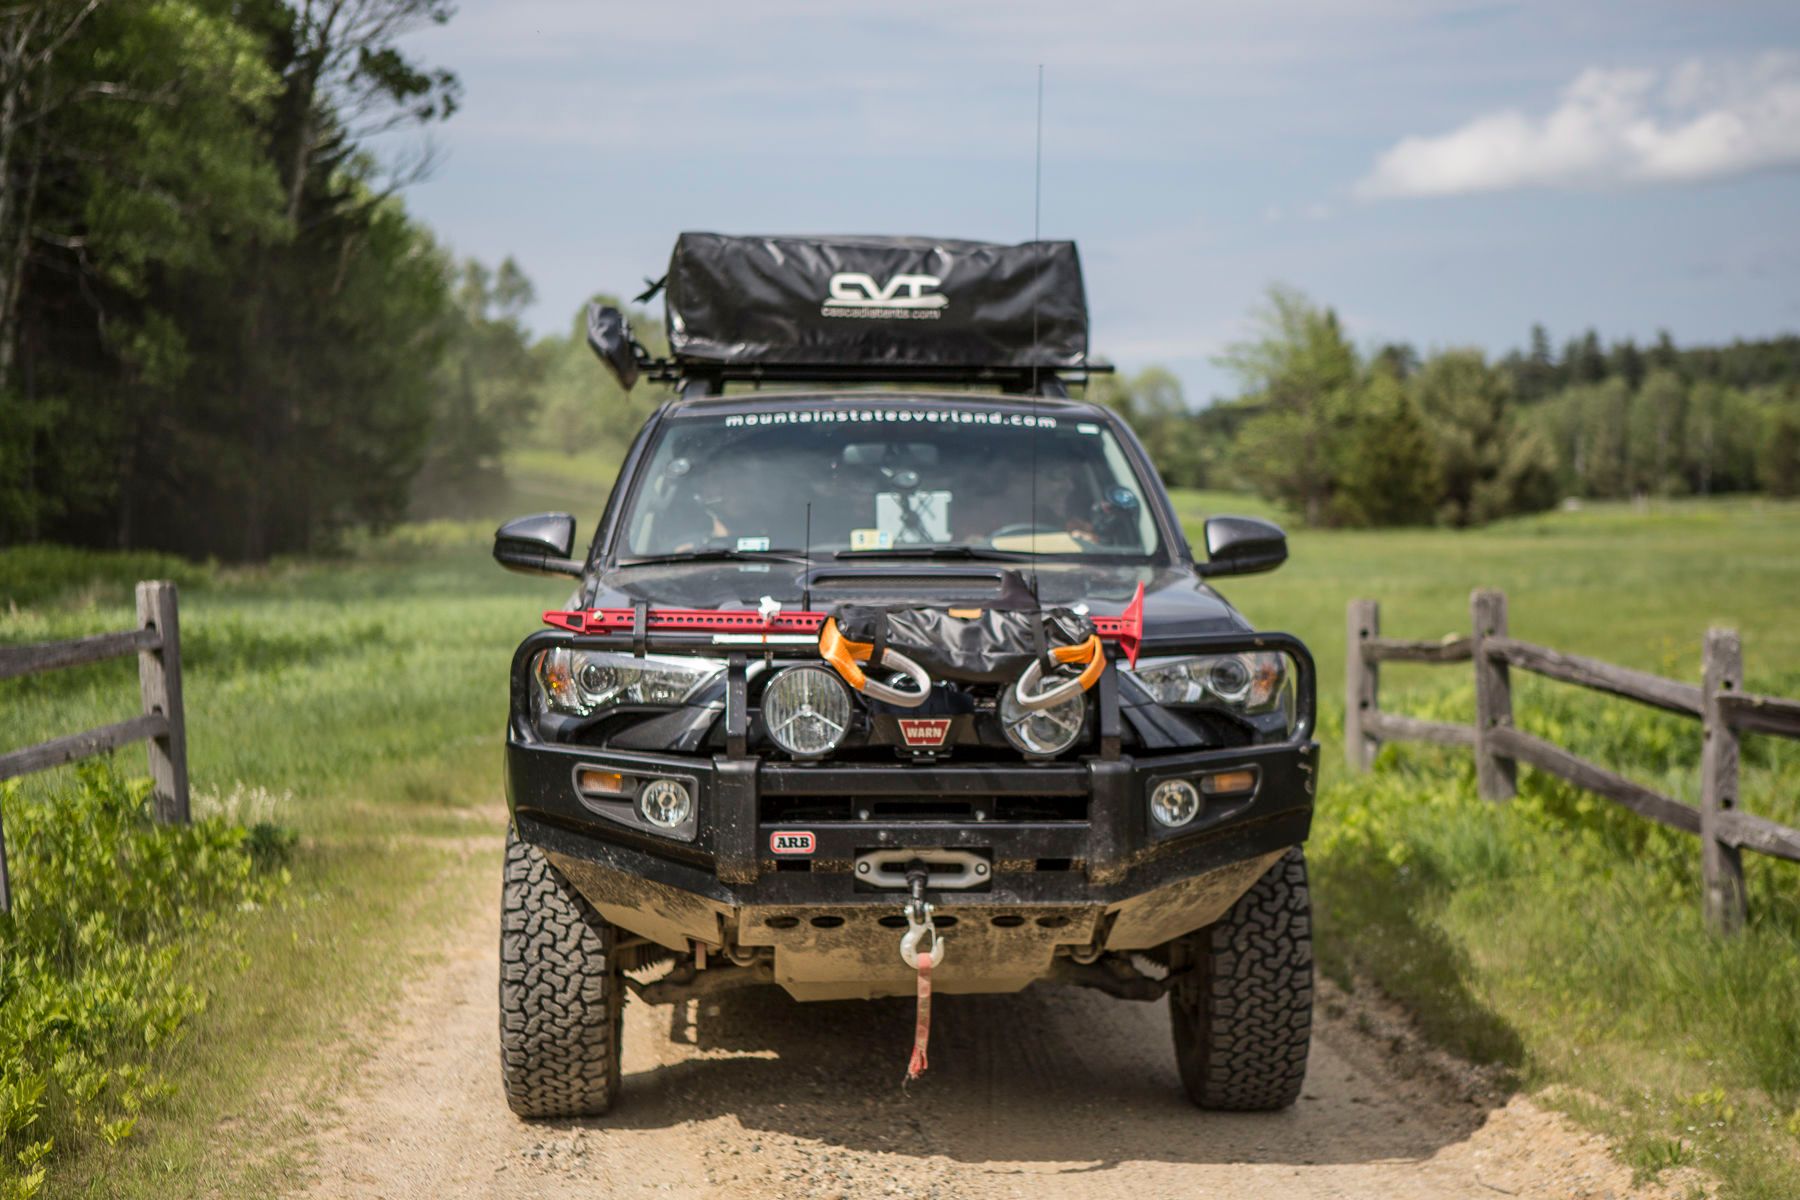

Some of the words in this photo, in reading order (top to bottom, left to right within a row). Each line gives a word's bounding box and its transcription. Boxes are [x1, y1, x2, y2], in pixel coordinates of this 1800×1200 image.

[725, 409, 1057, 429] mountainstateoverland.com
[906, 727, 942, 738] WARN
[776, 836, 810, 849] ARB
